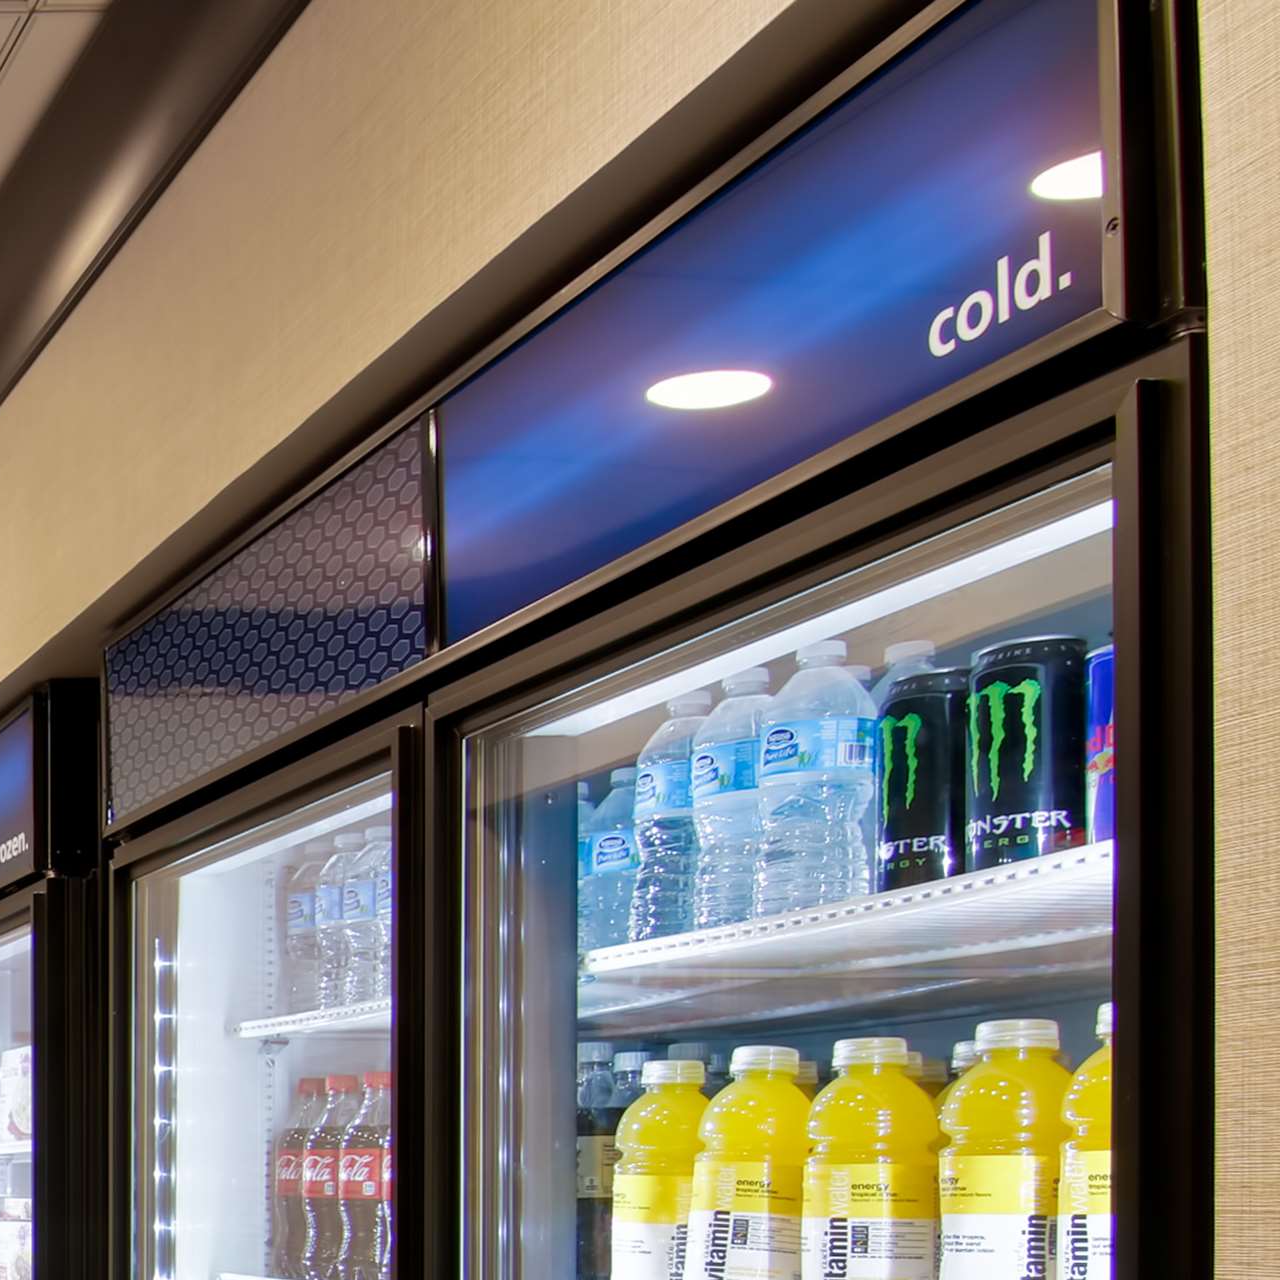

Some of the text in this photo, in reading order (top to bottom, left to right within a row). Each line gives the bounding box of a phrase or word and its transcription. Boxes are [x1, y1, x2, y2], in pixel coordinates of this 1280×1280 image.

[928, 231, 1071, 357] cold.
[878, 835, 948, 860] STER
[736, 1179, 772, 1188] energy
[851, 1183, 890, 1192] energy
